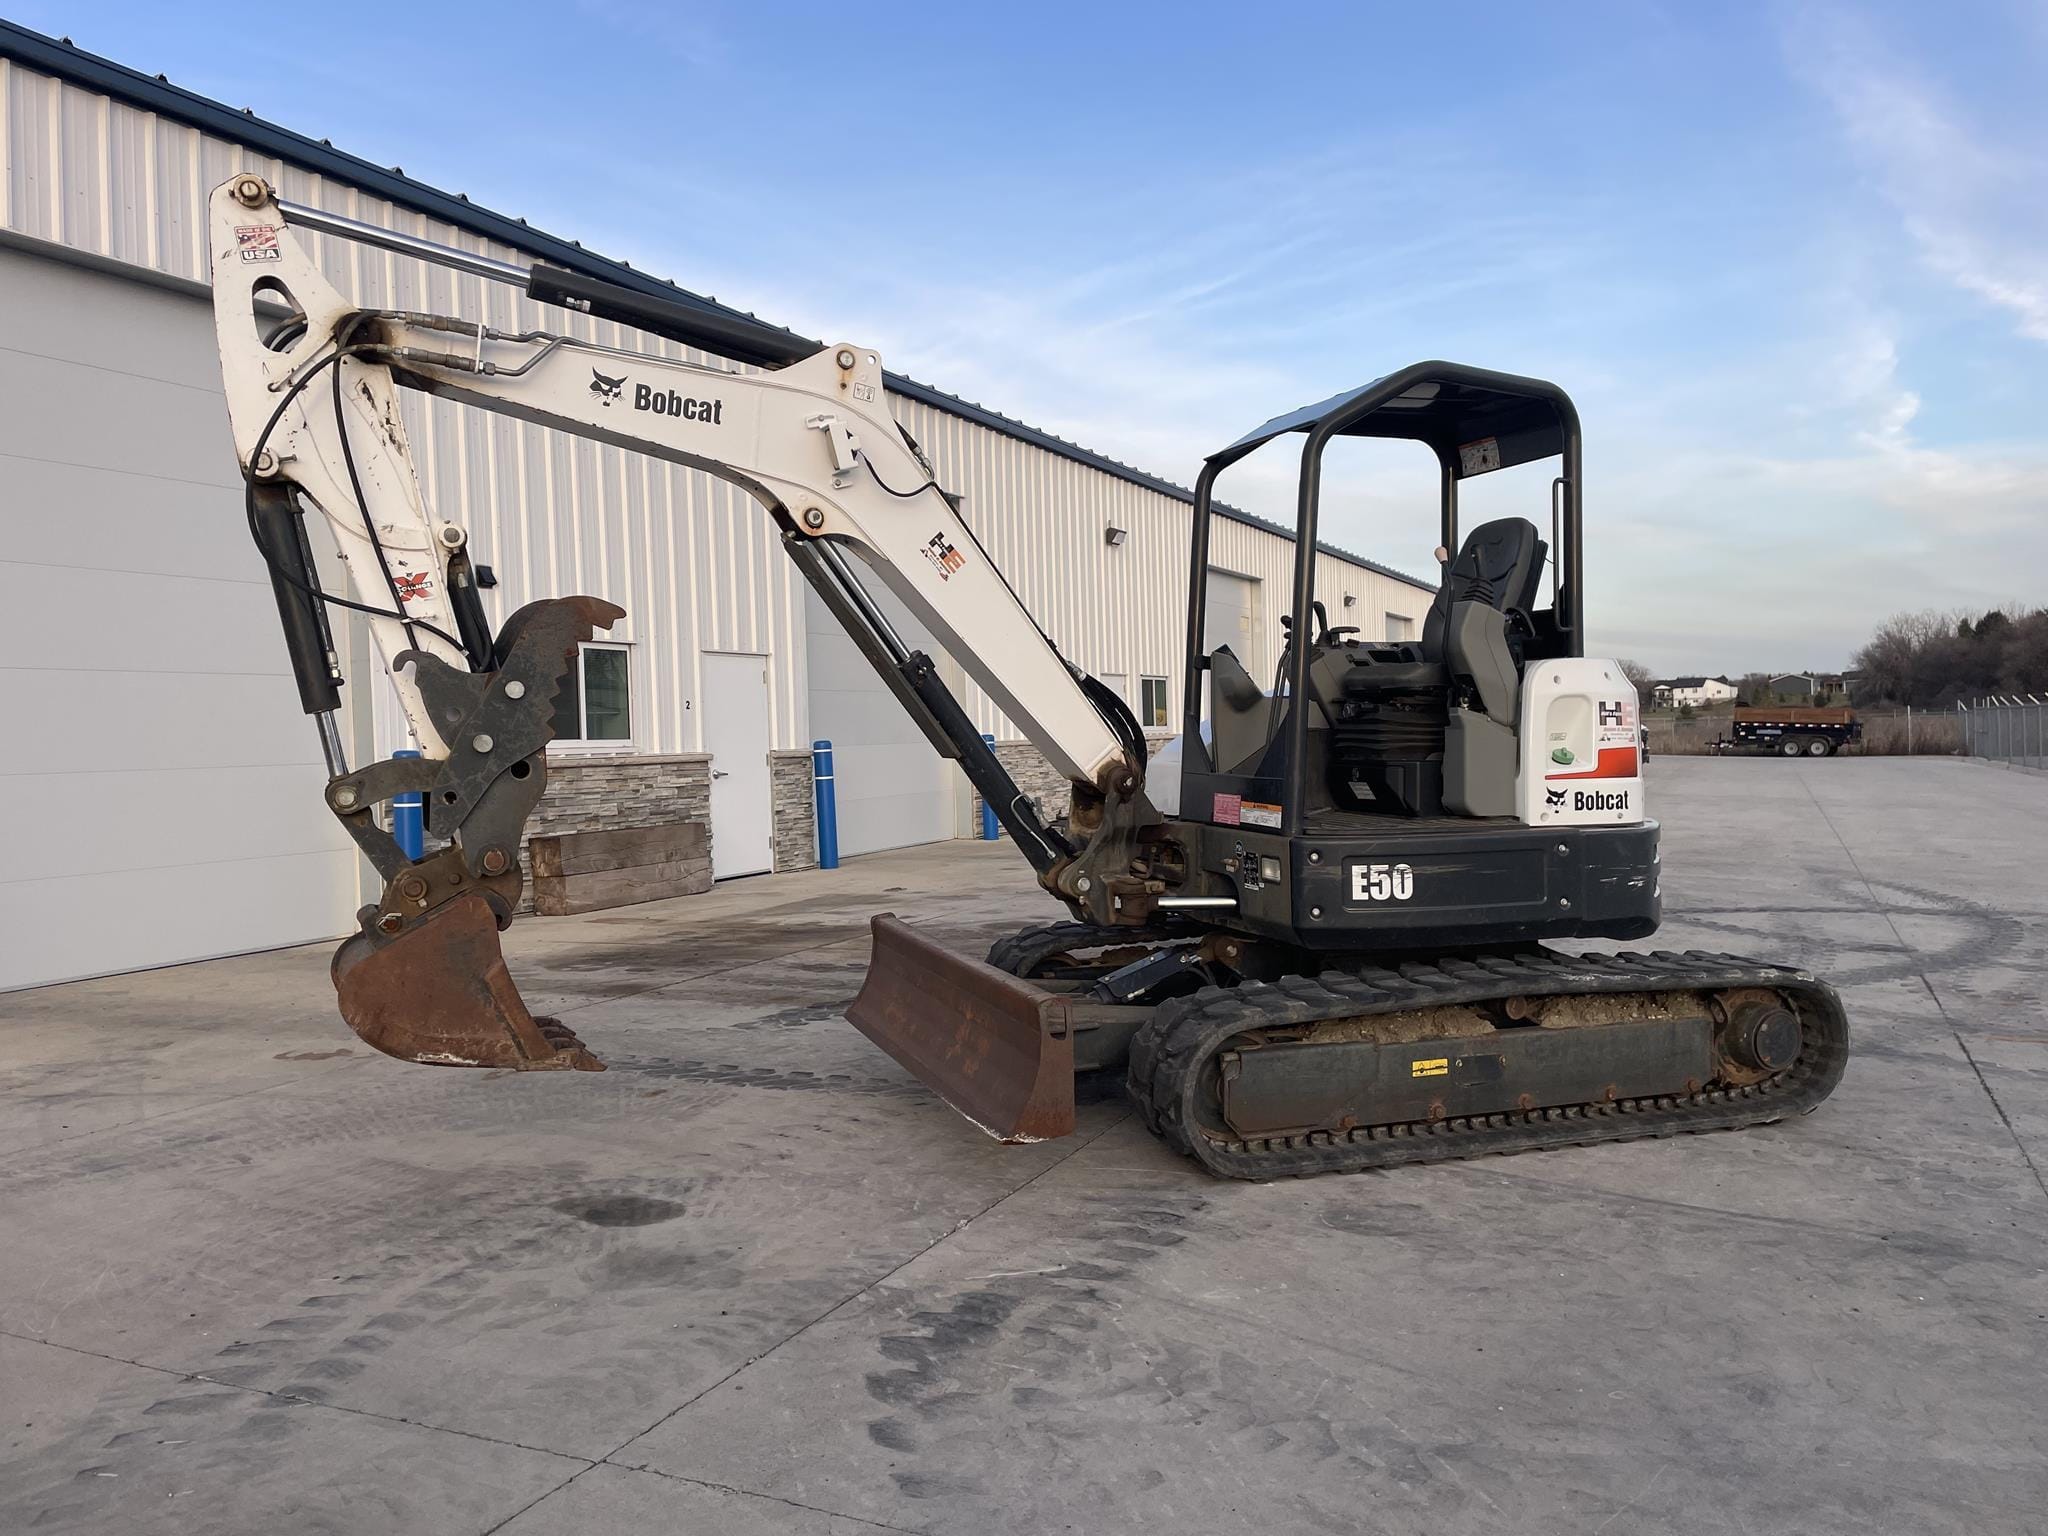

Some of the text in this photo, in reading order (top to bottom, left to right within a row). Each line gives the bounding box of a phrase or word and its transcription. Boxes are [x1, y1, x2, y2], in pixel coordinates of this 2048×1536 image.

[243, 250, 277, 259] USA
[634, 383, 723, 425] Bobcat
[685, 700, 691, 710] 2
[1574, 790, 1629, 811] Bobcat
[1351, 863, 1414, 901] E50
